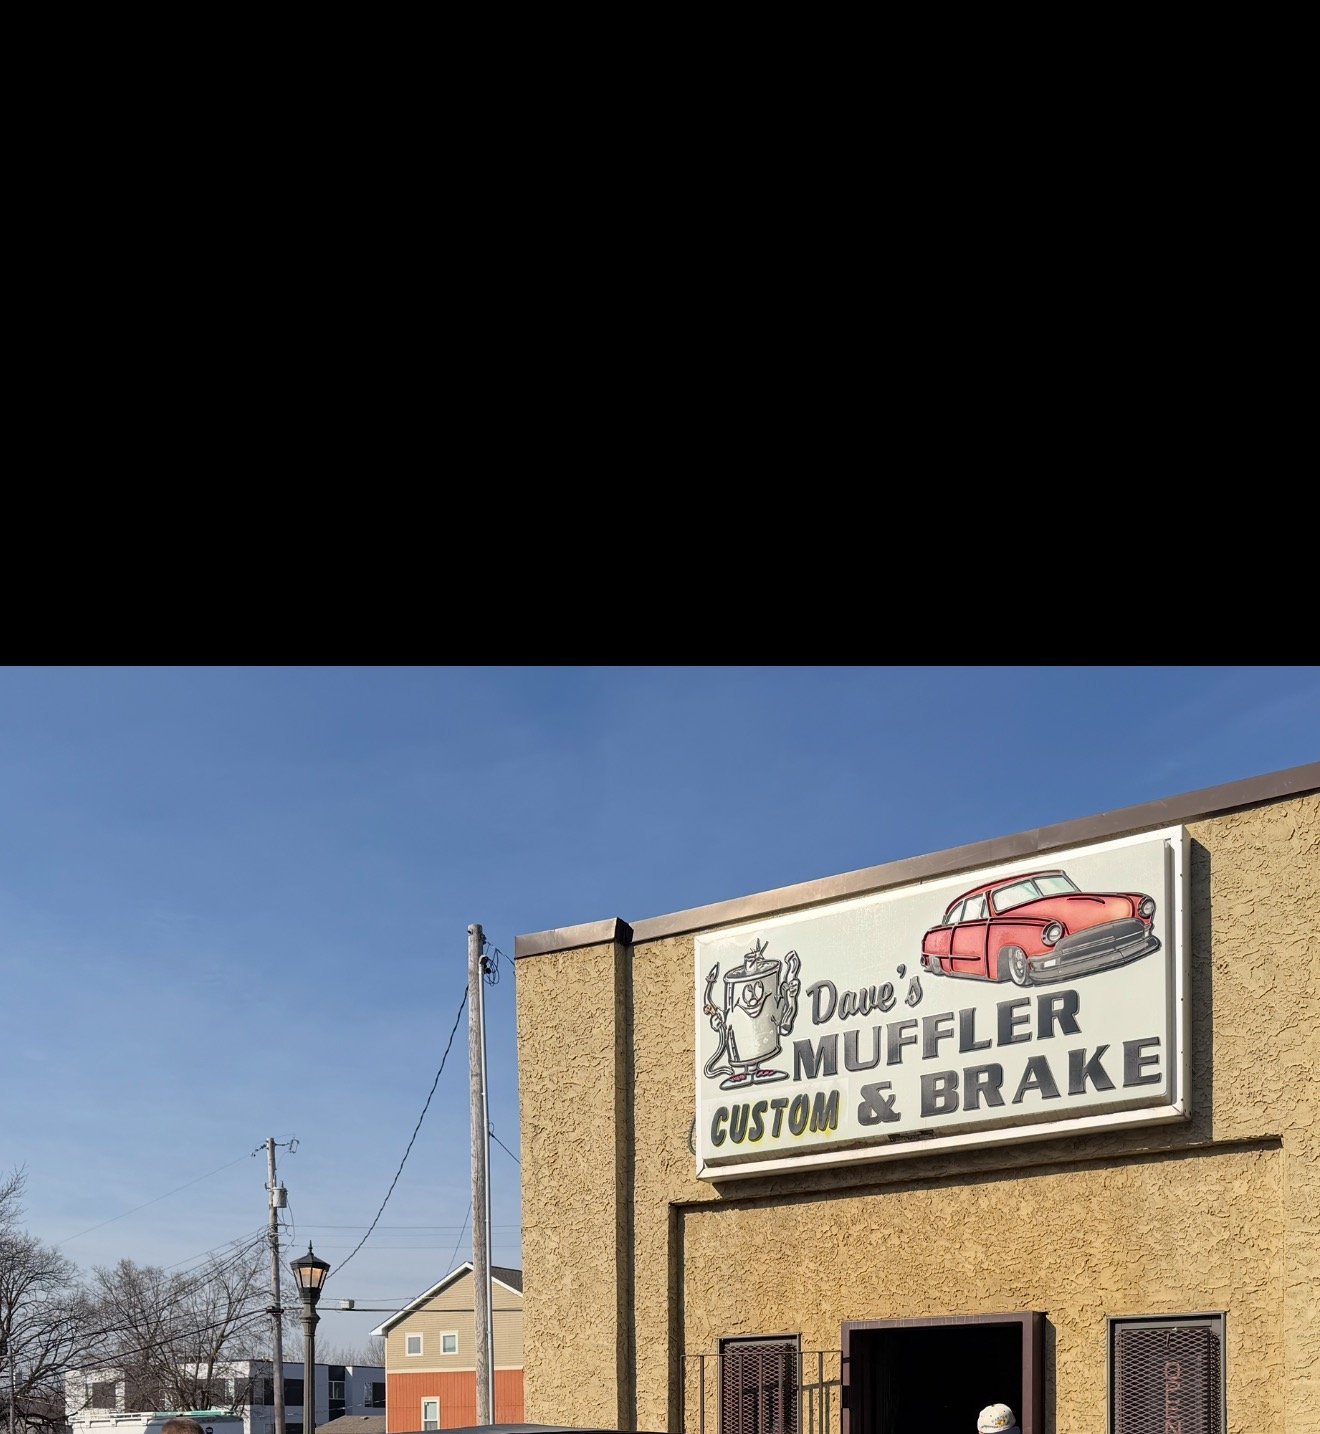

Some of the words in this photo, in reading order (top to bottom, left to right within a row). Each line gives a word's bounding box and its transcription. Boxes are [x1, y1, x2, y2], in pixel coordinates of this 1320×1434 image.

[807, 963, 924, 1025] Dave's
[792, 988, 1082, 1082] MUFFLER
[711, 1089, 840, 1147] CUSTOM
[857, 1080, 902, 1126] &
[919, 1036, 1162, 1119] BRAKE
